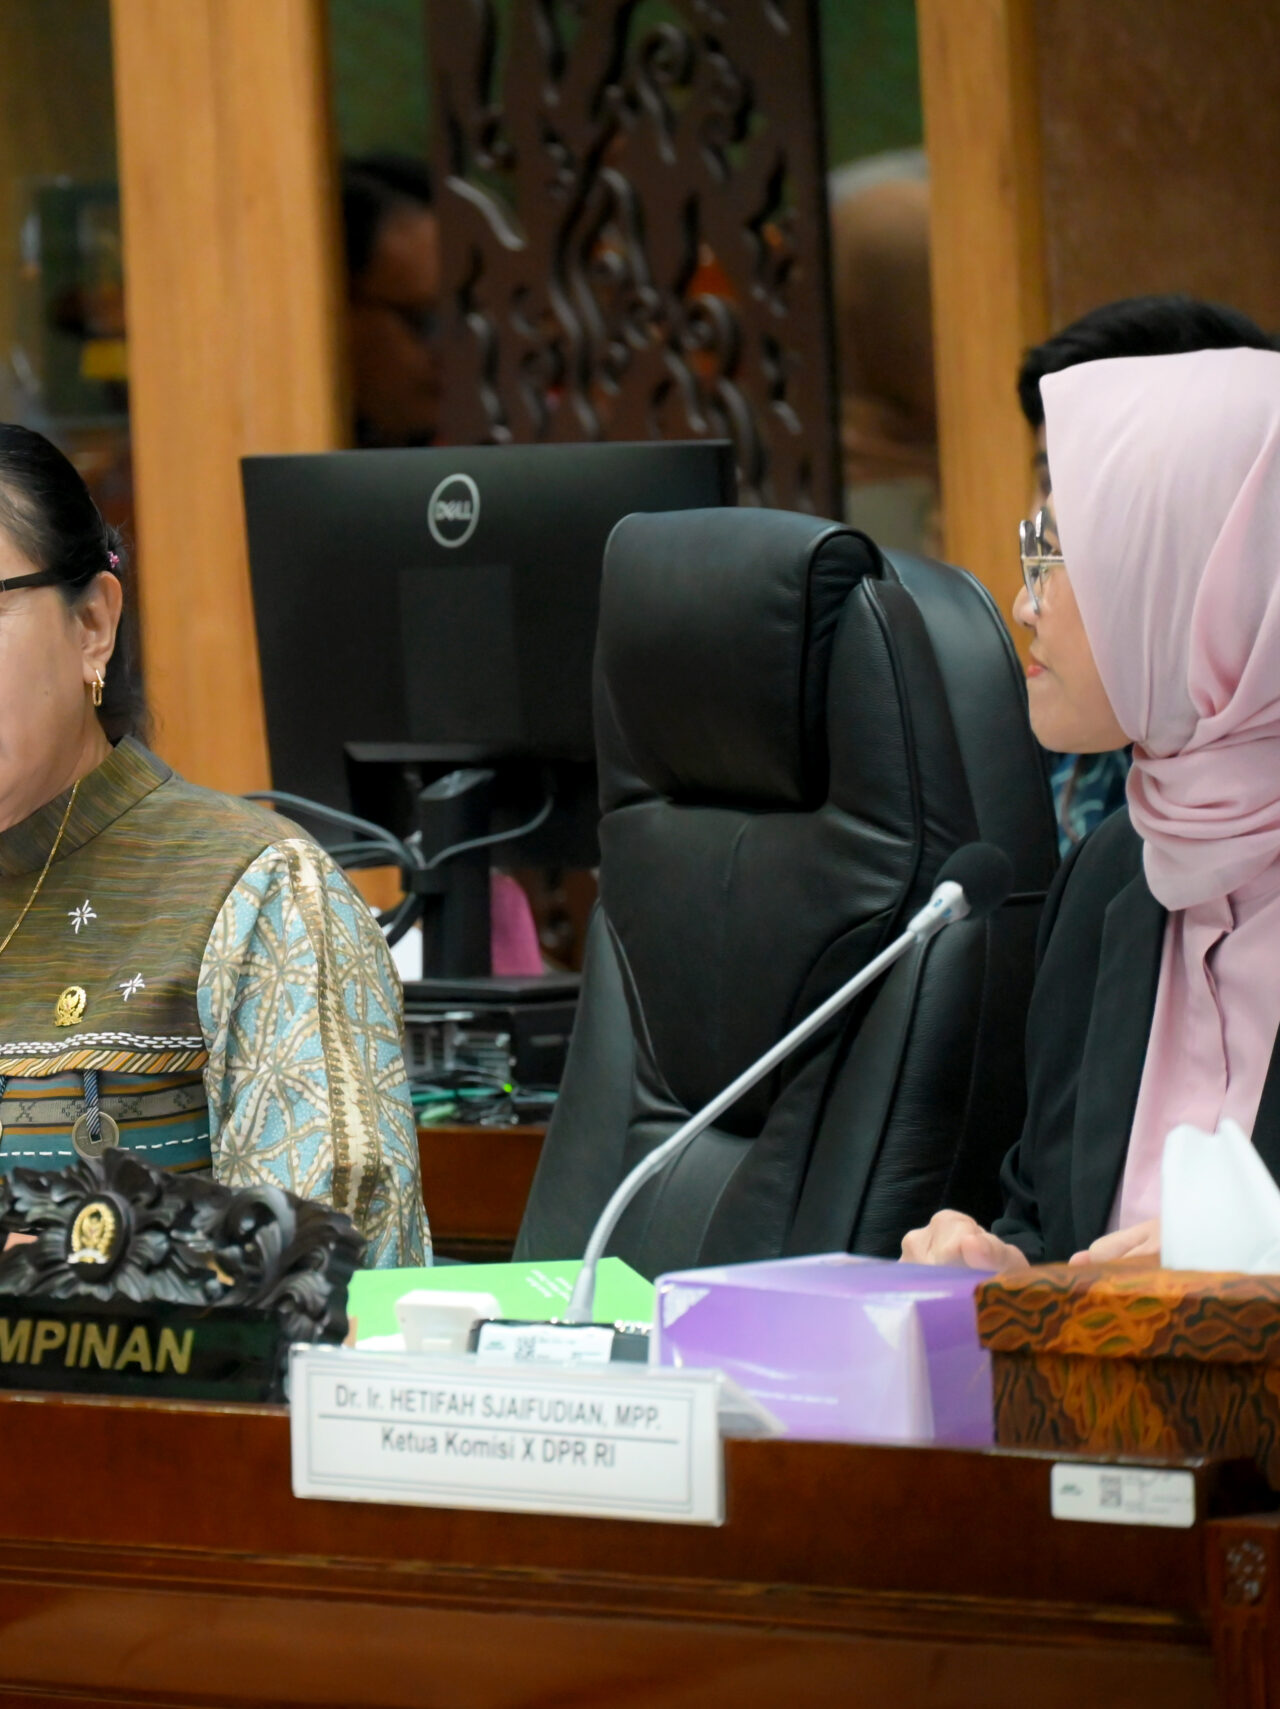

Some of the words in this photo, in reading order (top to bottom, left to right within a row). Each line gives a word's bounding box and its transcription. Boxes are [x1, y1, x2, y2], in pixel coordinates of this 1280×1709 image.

[334, 1384, 361, 1408] Dr.
[367, 1386, 384, 1410] Ir.
[390, 1388, 476, 1416] HETIFAH
[481, 1394, 608, 1427] SJAIFUDIAN,
[615, 1403, 662, 1430] MPP.
[381, 1426, 438, 1454] Ketua
[444, 1431, 515, 1461] Komisi
[521, 1436, 536, 1462] X
[542, 1438, 588, 1466] DPR
[594, 1441, 616, 1468] RI
